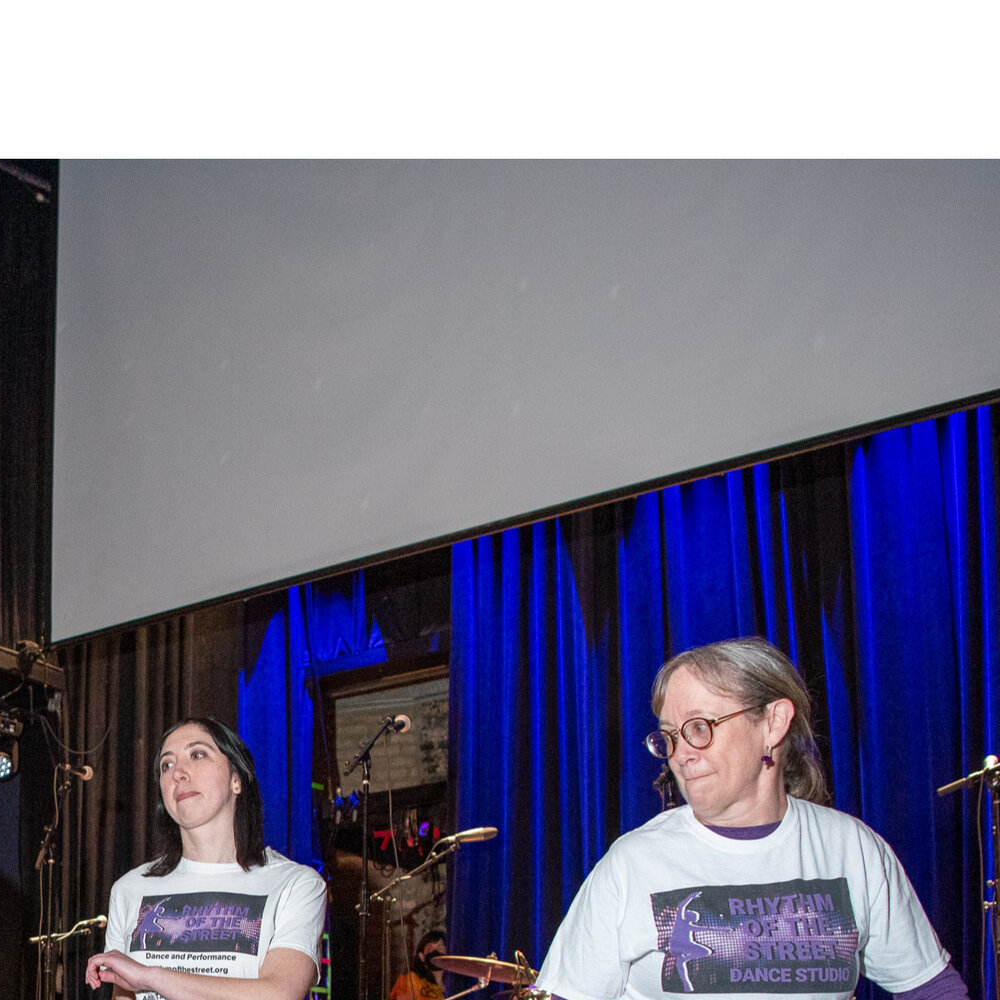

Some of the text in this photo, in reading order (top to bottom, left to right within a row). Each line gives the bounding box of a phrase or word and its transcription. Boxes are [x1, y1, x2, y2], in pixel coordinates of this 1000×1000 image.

[181, 904, 249, 916] RHYTHM
[728, 893, 835, 916] RHYTHM
[185, 917, 241, 928] OF THE
[745, 916, 836, 938] OF THE
[181, 929, 241, 940] STREET
[145, 952, 237, 962] Dance and Performance
[745, 940, 840, 961] STREET
[729, 966, 850, 983] DANCE STUDIO
